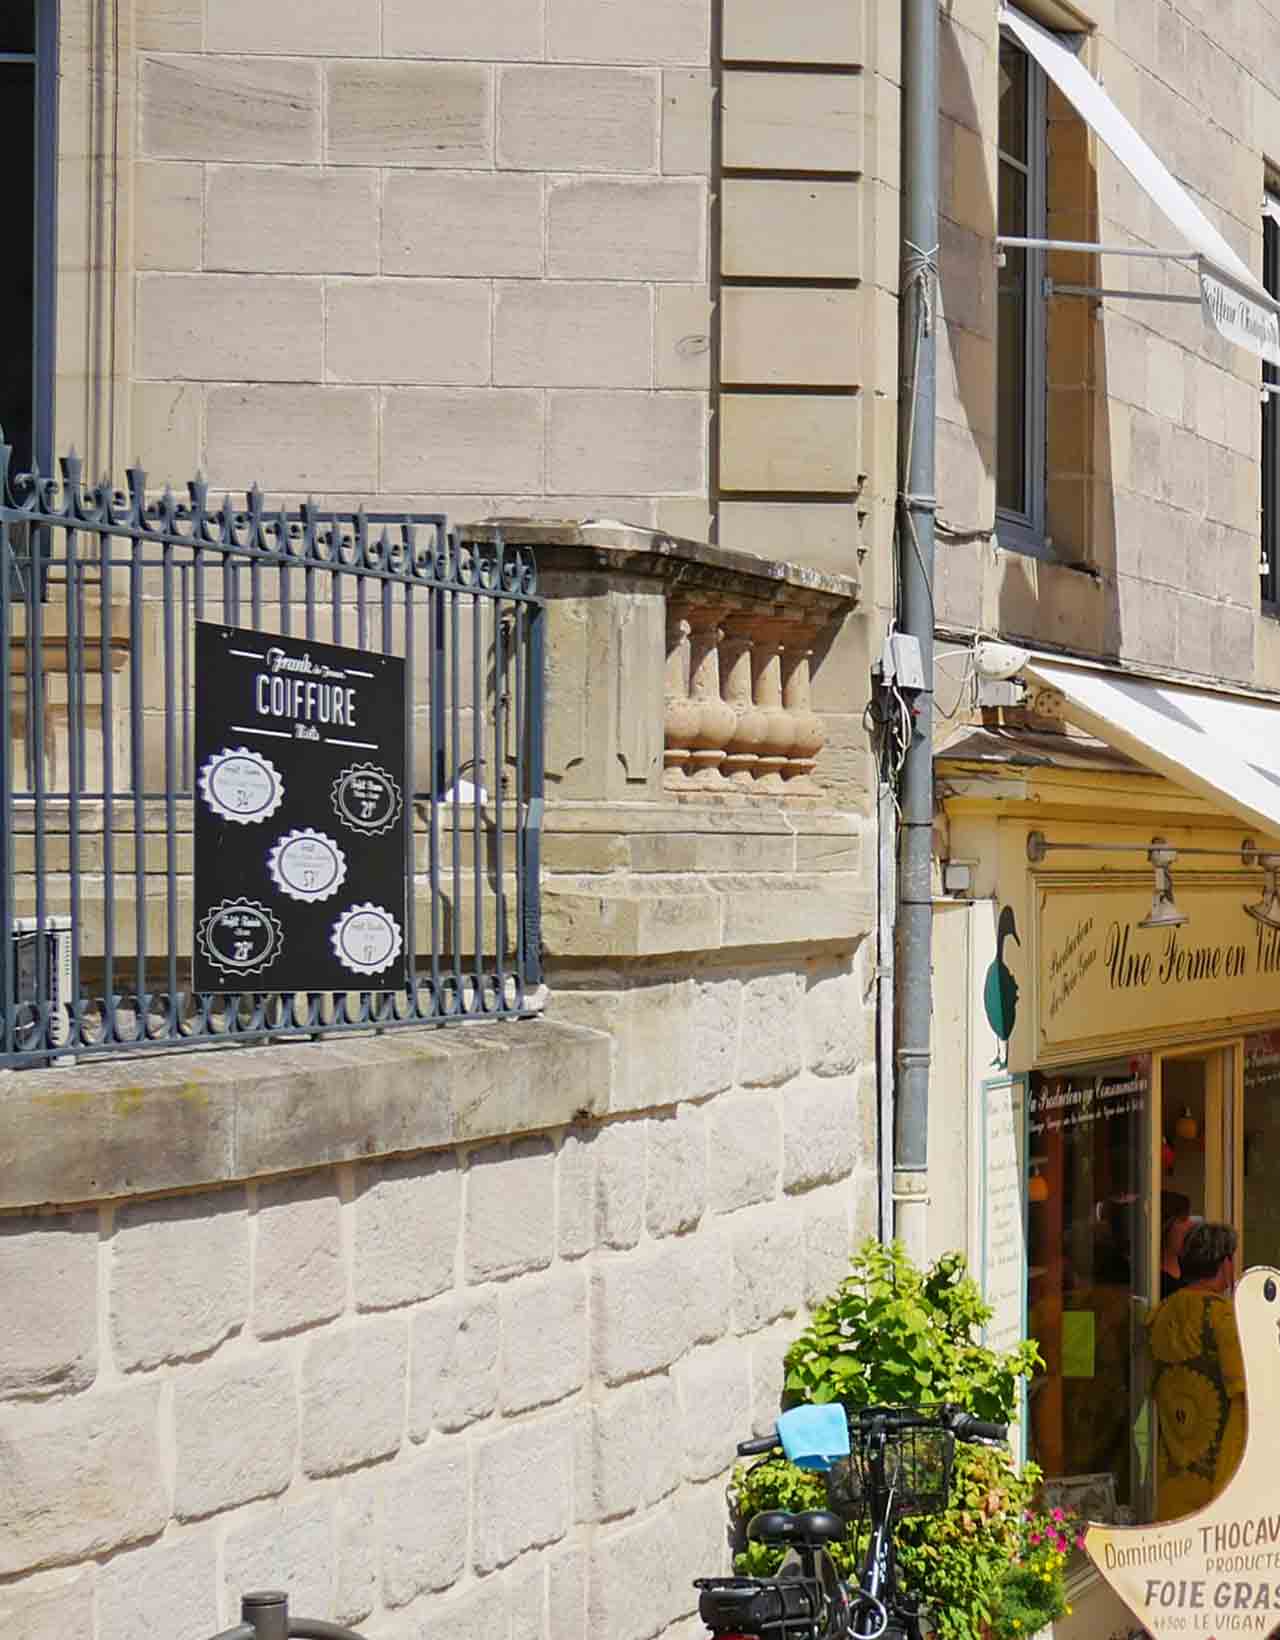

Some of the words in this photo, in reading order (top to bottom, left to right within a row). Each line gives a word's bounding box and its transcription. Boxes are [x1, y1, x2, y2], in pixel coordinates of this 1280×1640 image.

[256, 674, 356, 727] COIFFURE
[1103, 921, 1152, 990] Une
[1158, 926, 1221, 985] Ferme
[1225, 945, 1246, 977] en
[1104, 1535, 1193, 1570] Dominique
[1144, 1579, 1206, 1608] FOIE
[1194, 1614, 1209, 1631] LE
[1215, 1613, 1266, 1632] VIGAN
